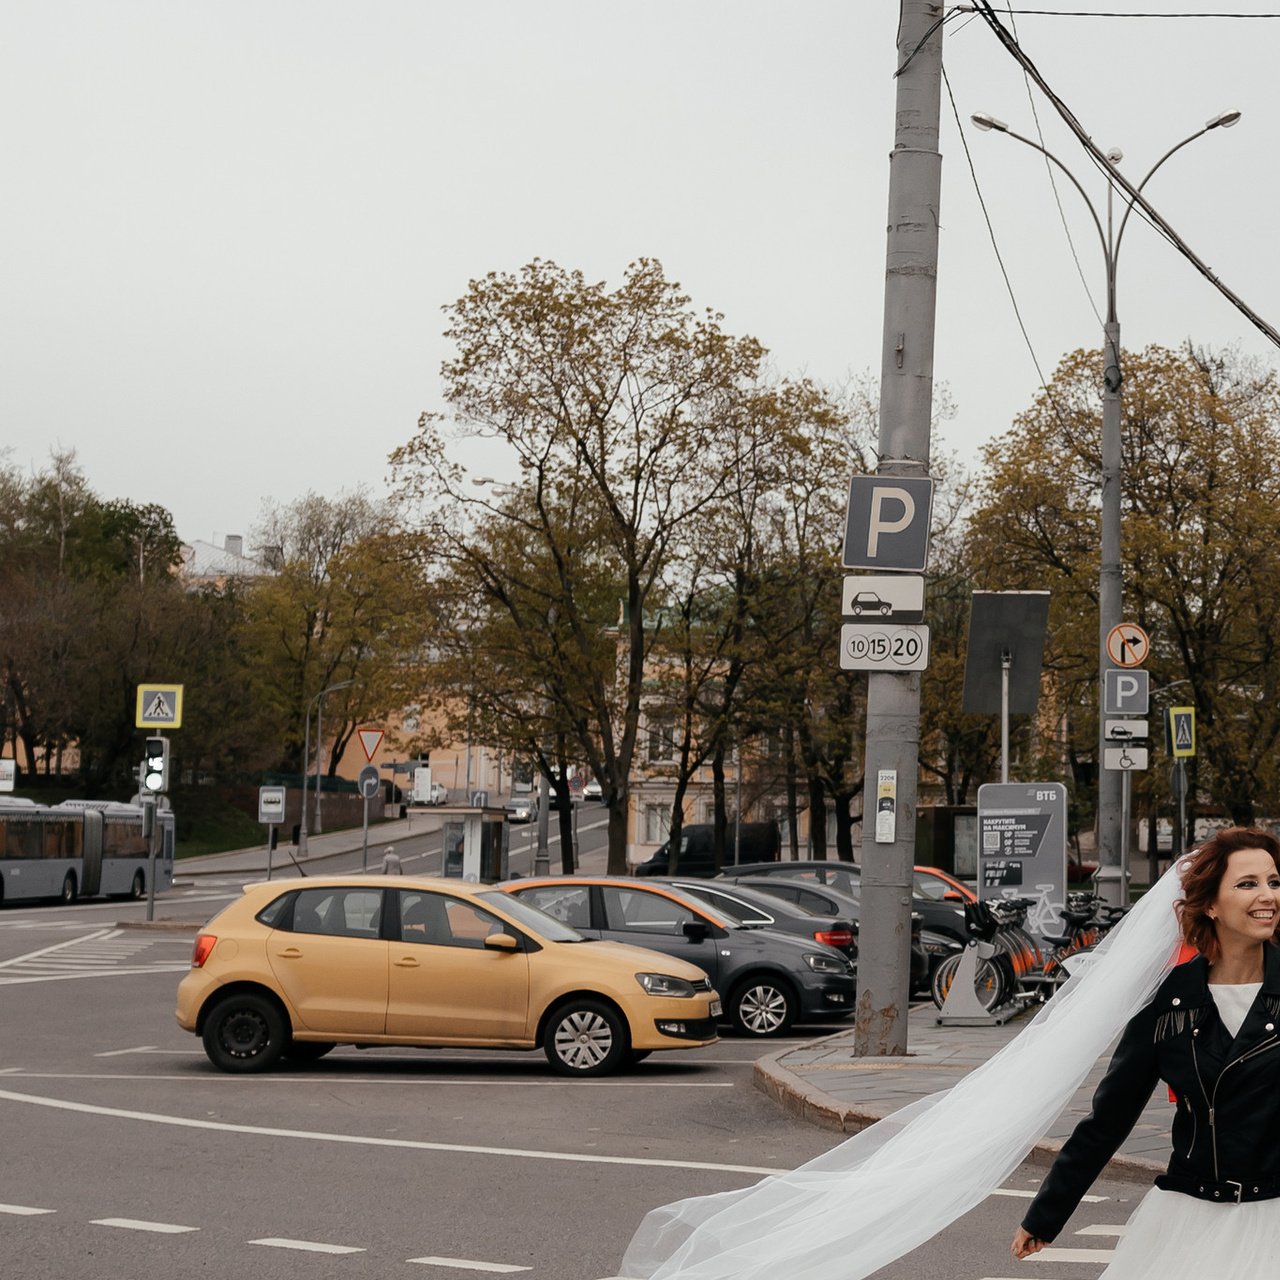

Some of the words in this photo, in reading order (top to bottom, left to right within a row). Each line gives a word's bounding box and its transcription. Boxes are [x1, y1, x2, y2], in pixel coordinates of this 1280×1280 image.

[867, 486, 915, 558] P
[851, 640, 864, 653] 10
[870, 638, 886, 655] 15
[893, 637, 918, 657] 20
[1116, 675, 1139, 708] P
[1036, 790, 1057, 801] ВТБ
